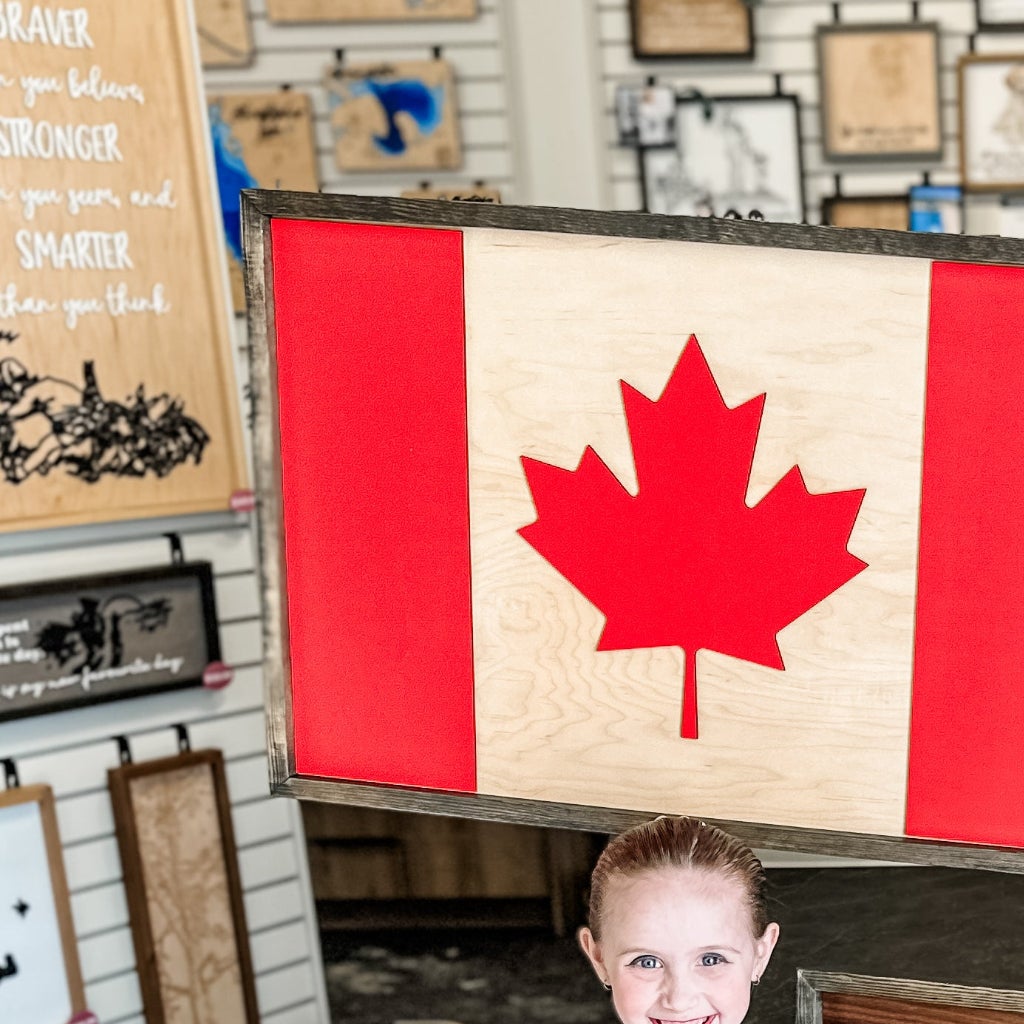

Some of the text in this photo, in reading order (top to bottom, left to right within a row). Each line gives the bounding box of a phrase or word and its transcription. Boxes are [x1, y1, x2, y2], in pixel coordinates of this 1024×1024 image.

[20, 75, 63, 109] you
[20, 188, 63, 220] you
[130, 179, 177, 208] and
[15, 229, 134, 269] SMARTER
[62, 298, 103, 330] you
[106, 282, 171, 317] think
